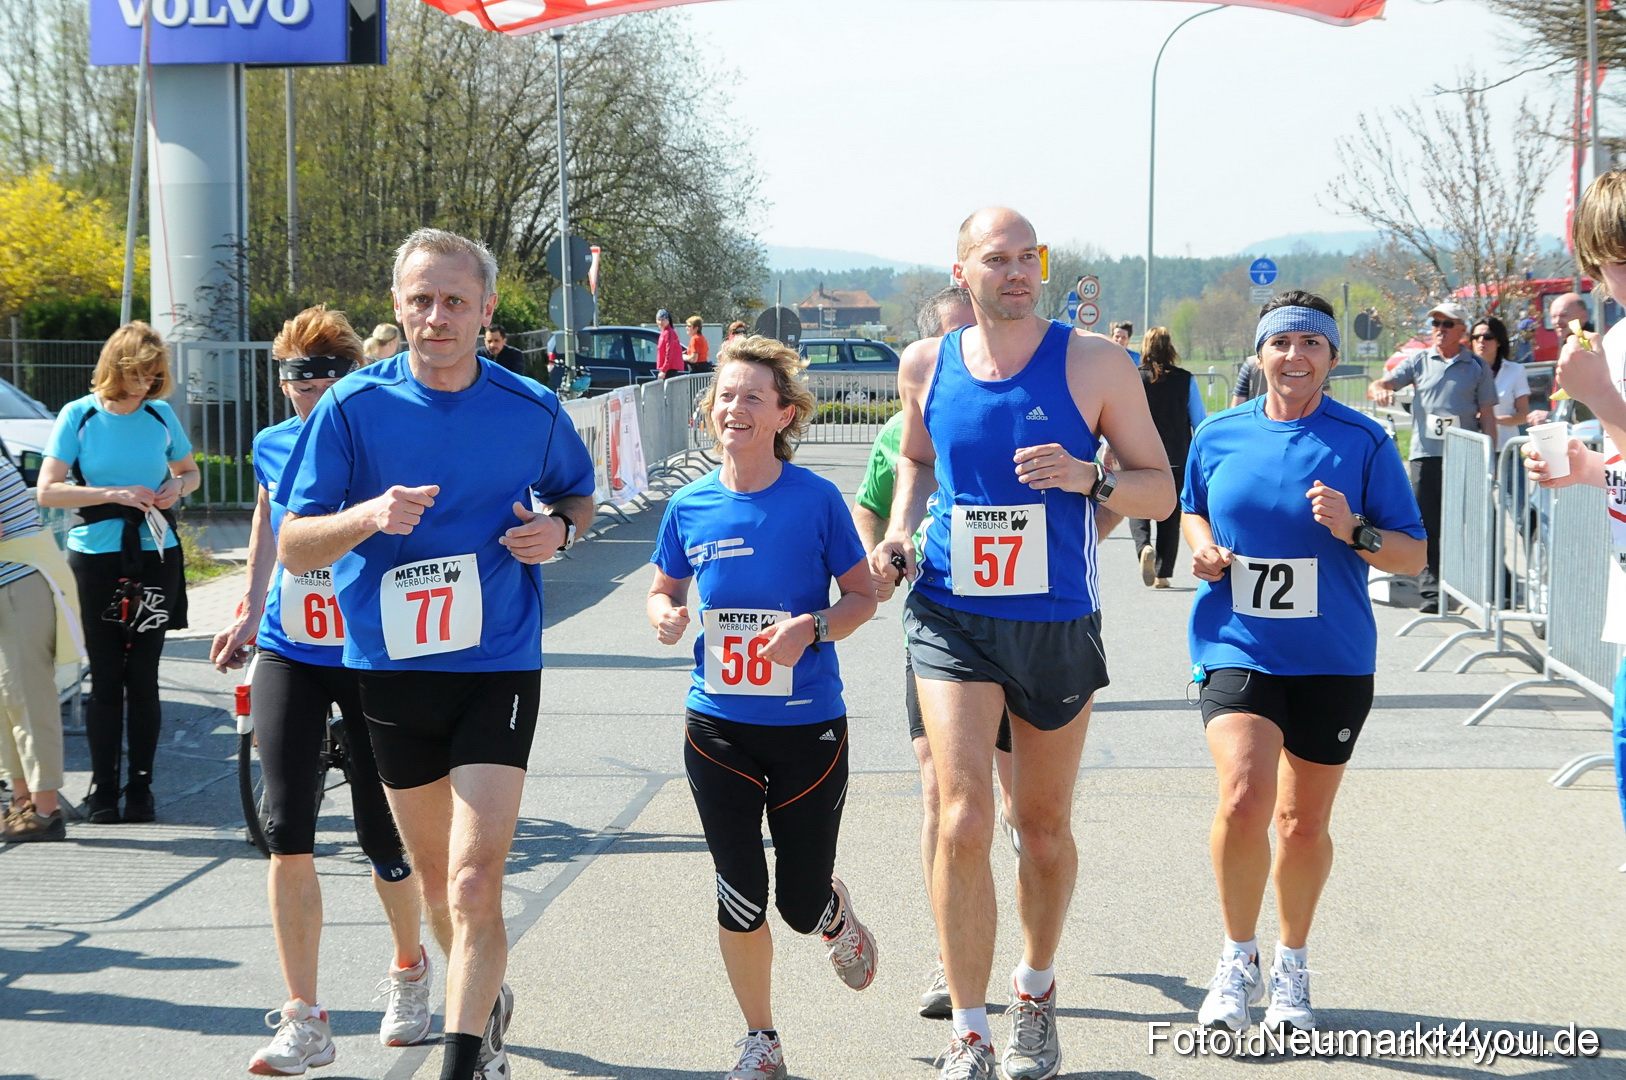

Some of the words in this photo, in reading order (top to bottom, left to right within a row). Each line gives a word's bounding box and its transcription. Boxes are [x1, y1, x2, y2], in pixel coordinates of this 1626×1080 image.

[118, 0, 310, 27] VOLVO
[1084, 284, 1096, 295] 60
[965, 510, 1007, 521] MEYER
[965, 521, 1009, 530] WERBUNG
[973, 535, 1023, 588] 57
[394, 562, 439, 582] MEYER
[293, 577, 332, 587] WERBUNG
[395, 574, 442, 589] WERBUNG
[1248, 562, 1294, 610] 72
[303, 592, 345, 639] 61
[405, 586, 454, 645] 77
[718, 612, 758, 624] MEYER
[719, 623, 759, 632] WERBUNG
[721, 635, 772, 686] 58
